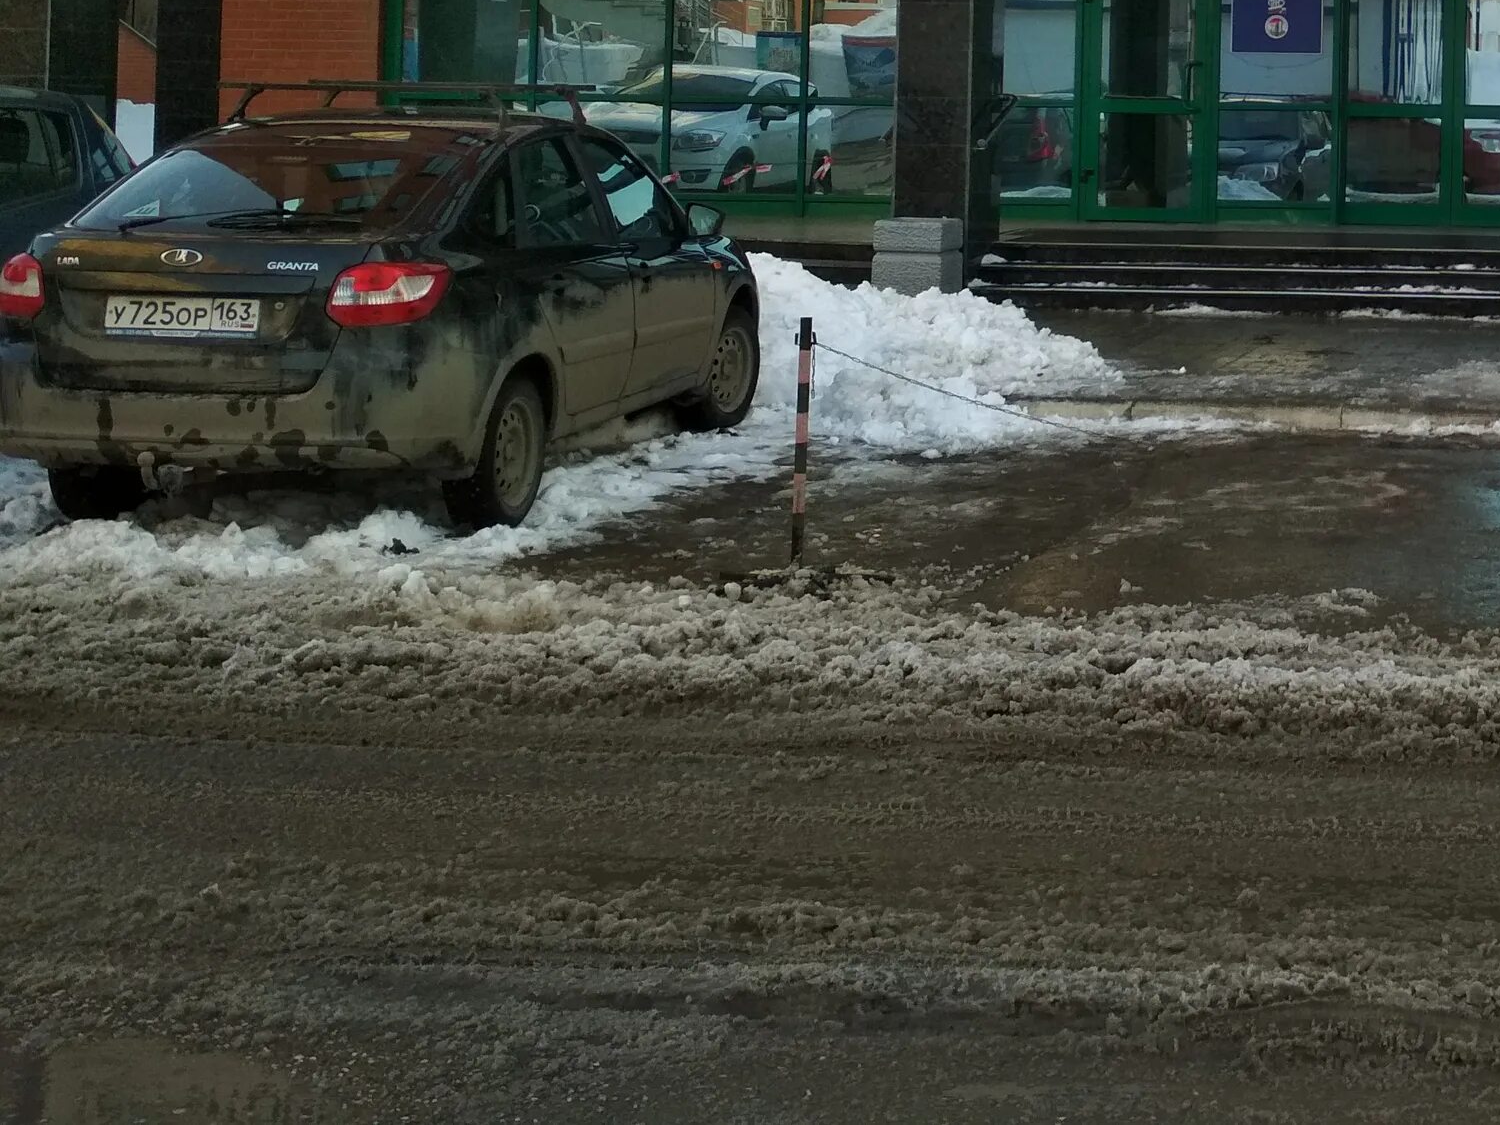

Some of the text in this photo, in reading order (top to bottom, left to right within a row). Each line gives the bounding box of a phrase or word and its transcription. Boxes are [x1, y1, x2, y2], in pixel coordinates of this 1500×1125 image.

[57, 256, 79, 265] LADA
[267, 261, 319, 271] GRANTA
[214, 302, 251, 321] 163
[221, 320, 240, 328] RUS
